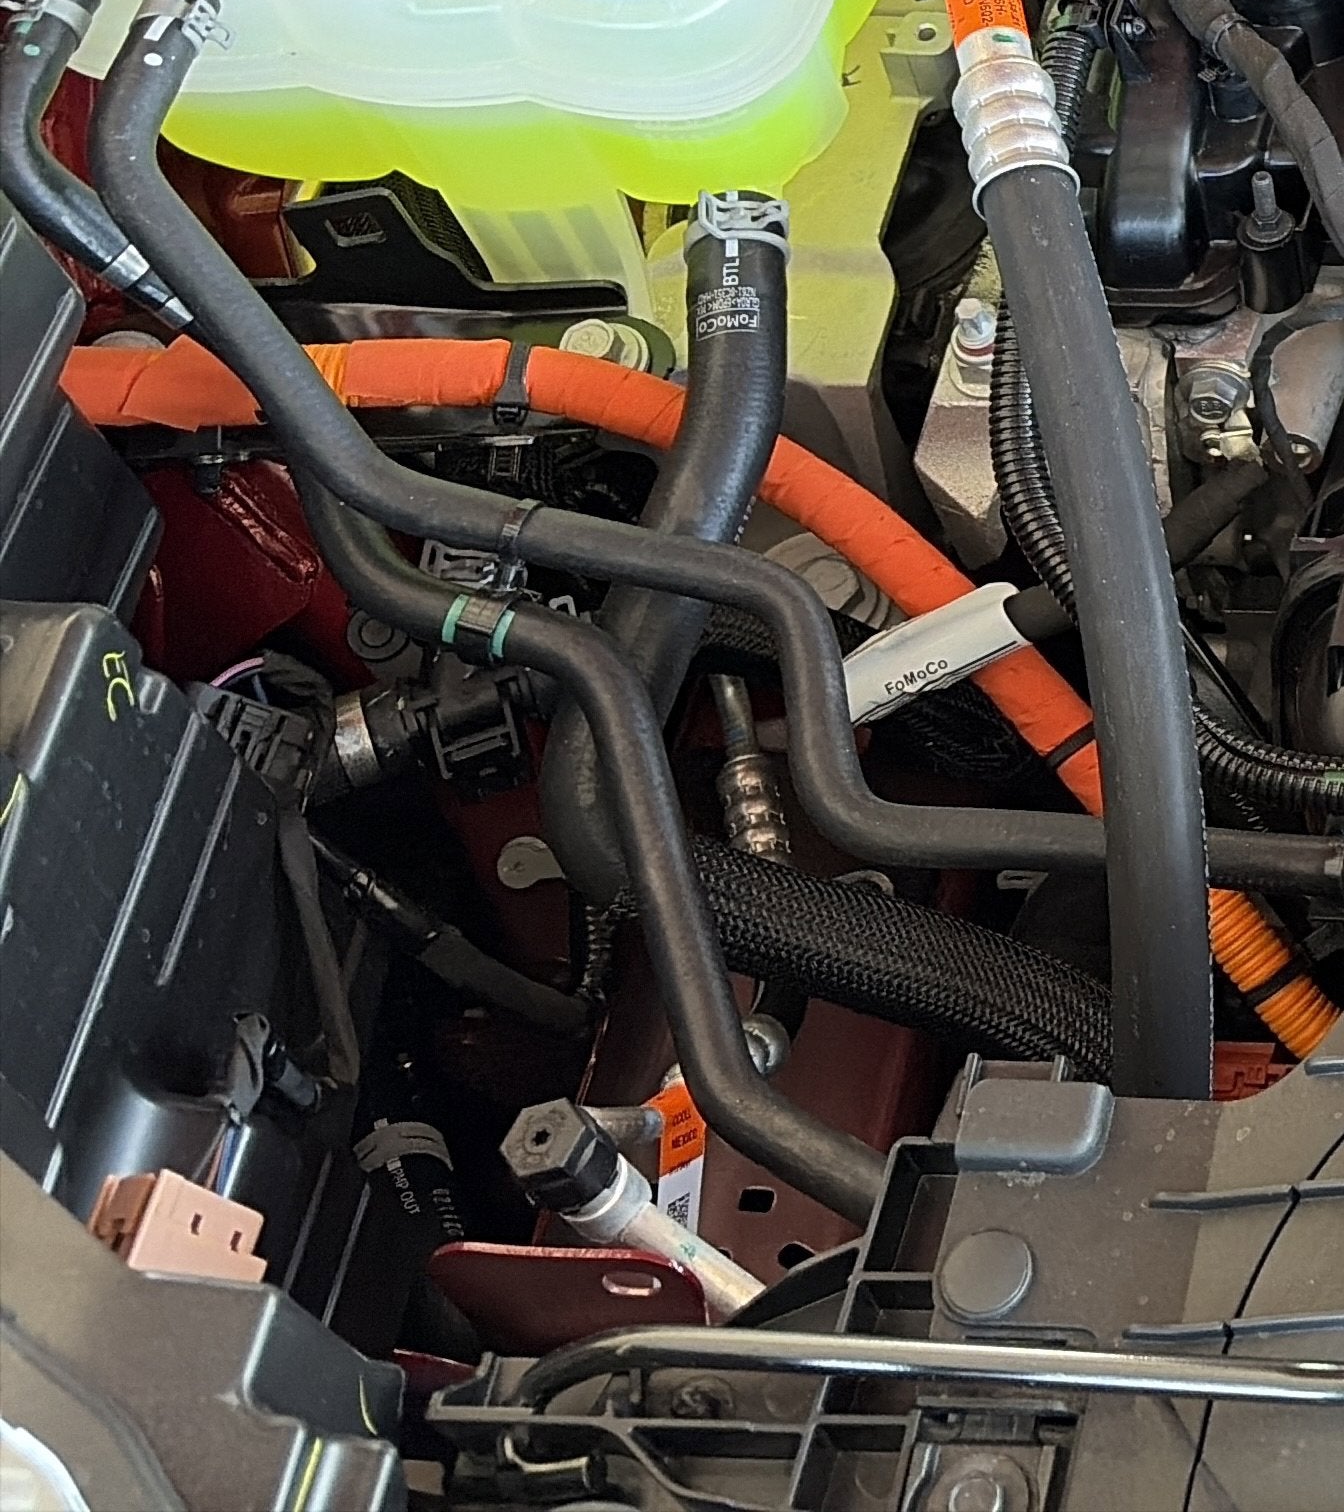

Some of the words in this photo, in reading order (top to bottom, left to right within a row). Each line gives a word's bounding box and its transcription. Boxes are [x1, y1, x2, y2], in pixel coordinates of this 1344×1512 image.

[722, 258, 740, 286] BTL
[698, 313, 758, 334] FoMoCo
[883, 659, 949, 696] FoMoCo
[400, 1191, 421, 1214] OUT
